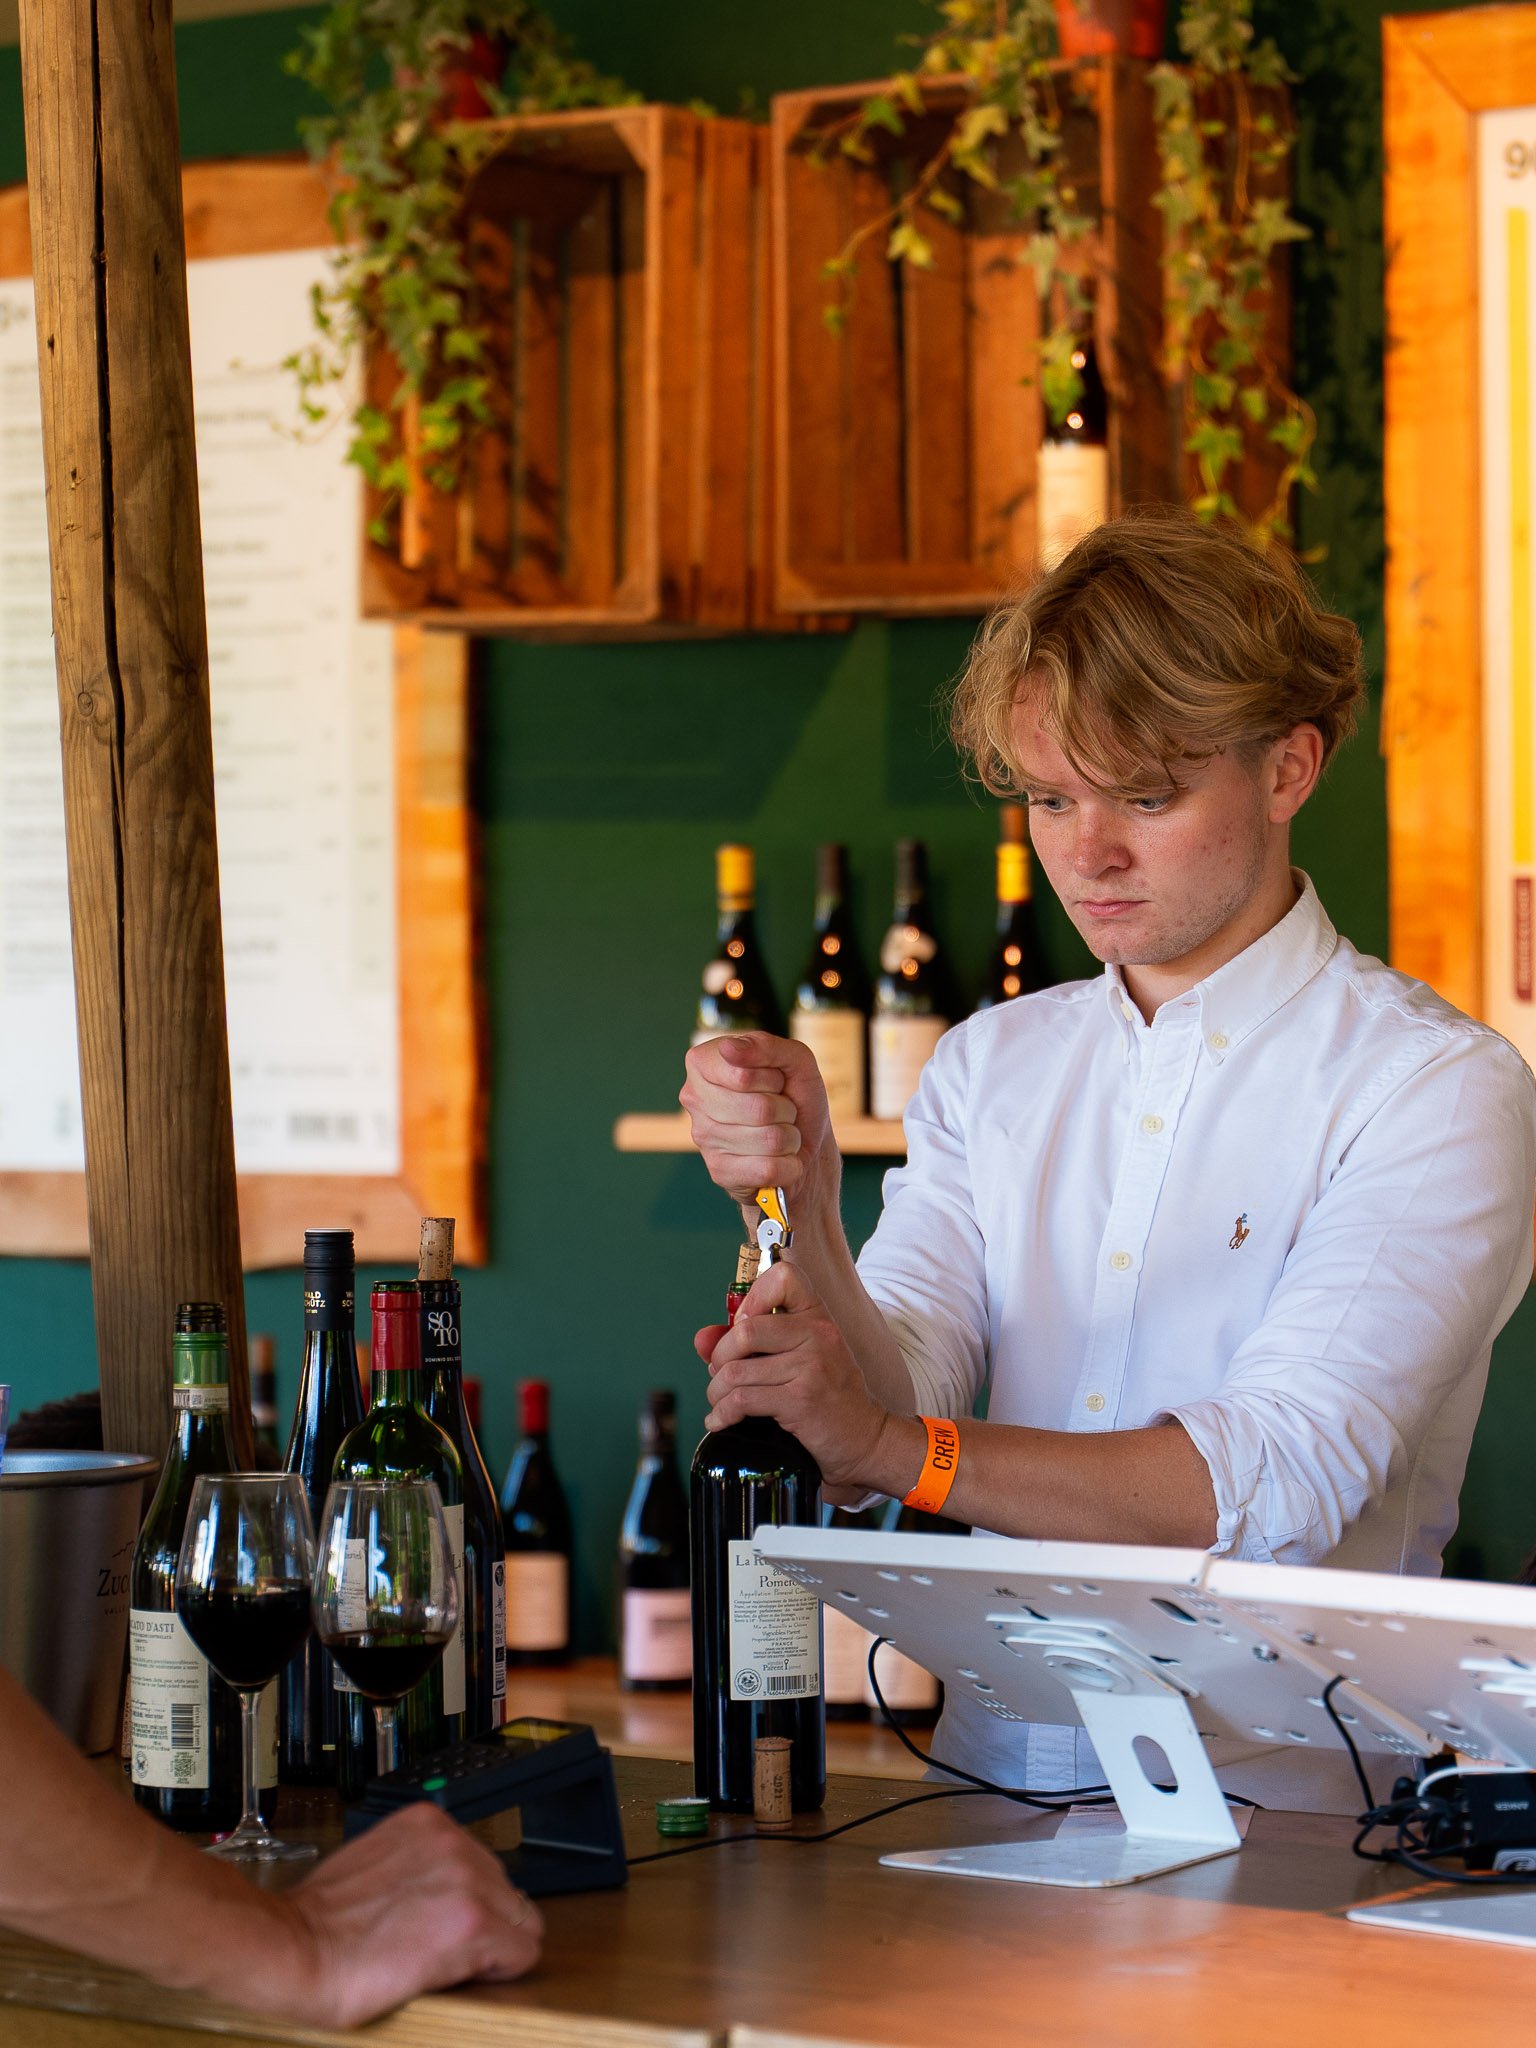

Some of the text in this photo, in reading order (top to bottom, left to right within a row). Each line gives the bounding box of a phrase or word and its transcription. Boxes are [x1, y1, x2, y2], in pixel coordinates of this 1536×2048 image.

[428, 1311, 453, 1331] SO
[433, 1327, 459, 1347] TO
[932, 1426, 955, 1471] CREW
[735, 1554, 751, 1567] La
[146, 1622, 175, 1634] D'ASTI
